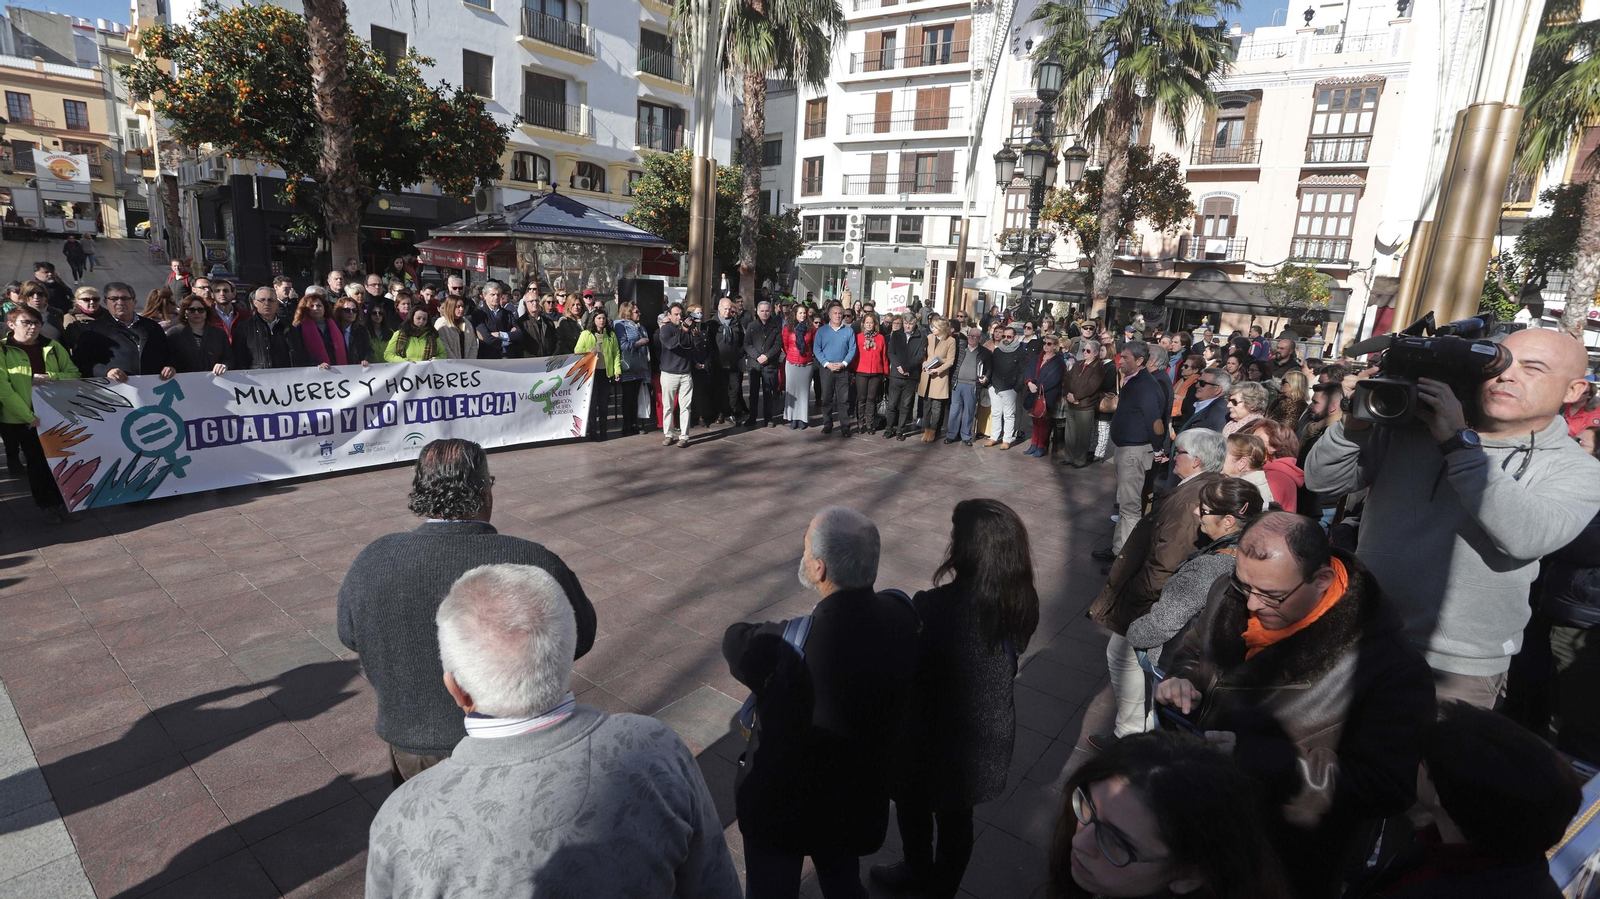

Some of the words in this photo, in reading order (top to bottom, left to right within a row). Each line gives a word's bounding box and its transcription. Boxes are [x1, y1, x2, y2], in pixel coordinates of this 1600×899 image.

[234, 378, 351, 406] MUJERES
[359, 377, 376, 396] Y
[385, 370, 481, 394] HOMBRES
[518, 391, 549, 401] Victoria
[552, 389, 572, 398] Kent
[188, 411, 333, 448] IGUALDAD
[342, 410, 356, 431] Y
[367, 403, 396, 428] NO
[406, 394, 513, 422] VIOLENCIA
